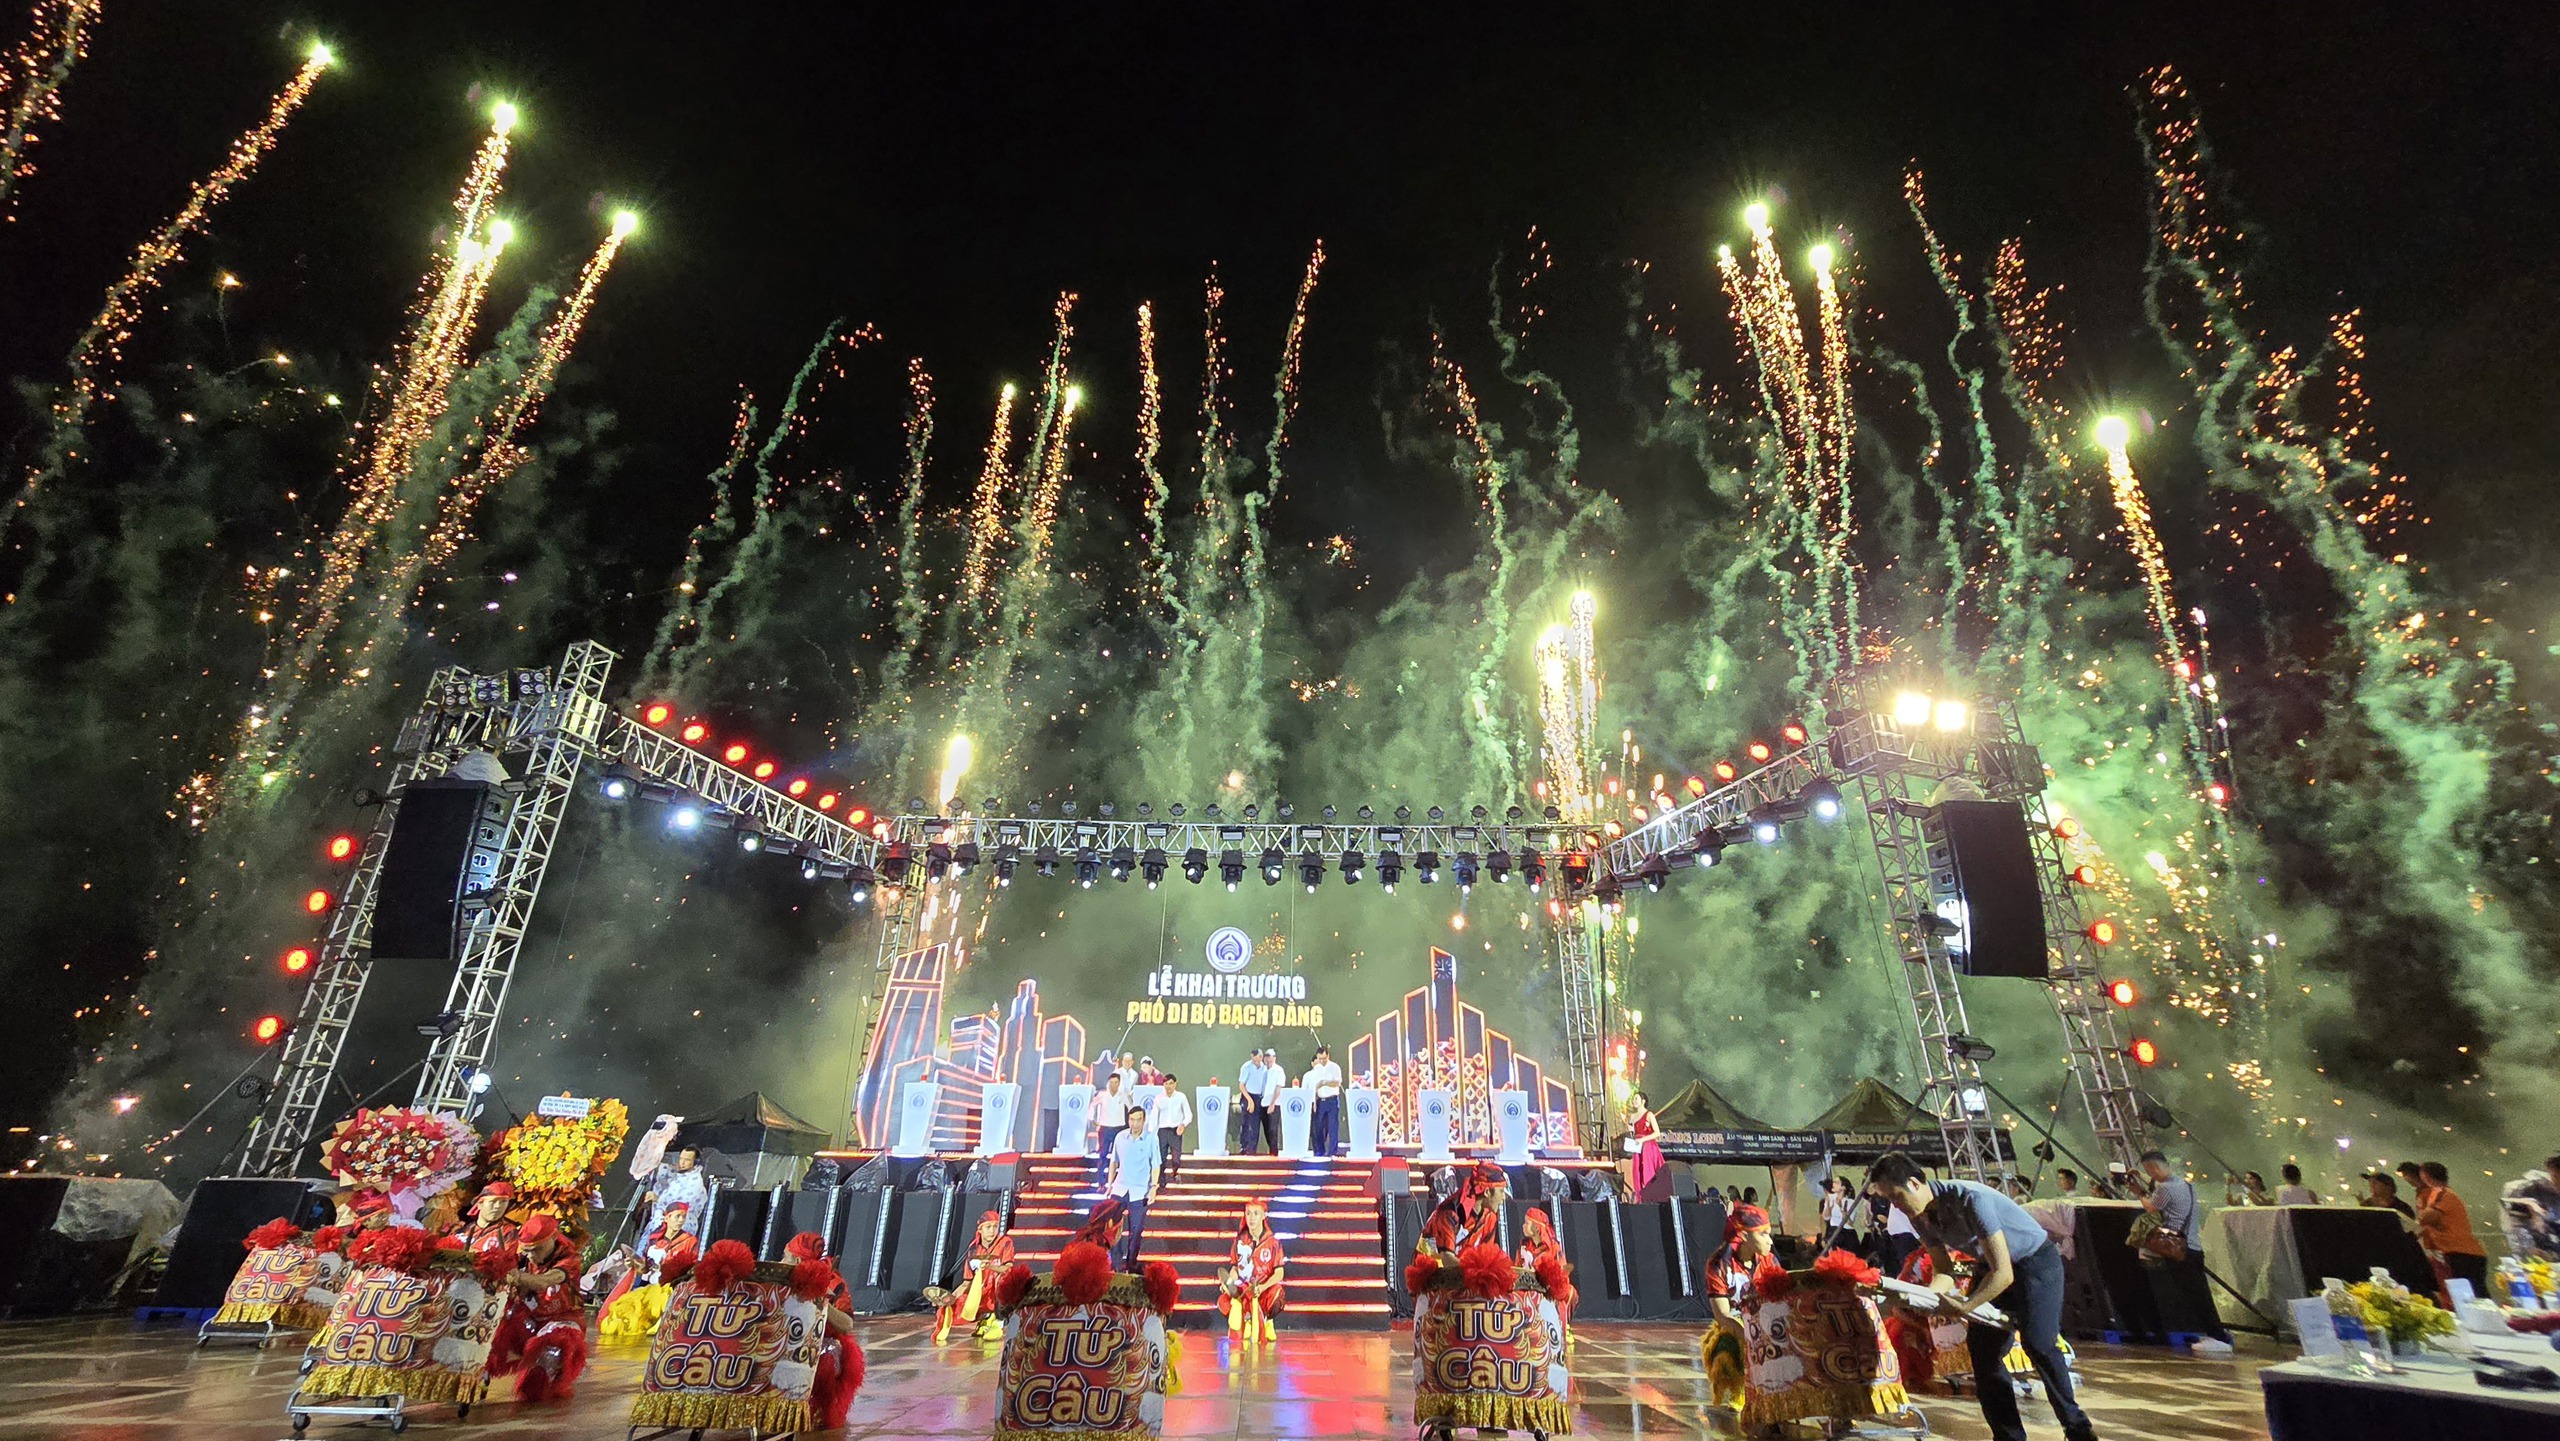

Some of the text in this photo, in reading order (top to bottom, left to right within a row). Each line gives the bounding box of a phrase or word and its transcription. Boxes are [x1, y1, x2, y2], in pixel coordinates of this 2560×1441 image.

[1148, 965, 1306, 1000] LỄ KHAI TRƯƠNG
[1127, 995, 1165, 1024] PHỐ
[1167, 1002, 1188, 1024] ĐI
[1191, 999, 1216, 1028] BỘ
[1219, 1004, 1269, 1029] BẠCH
[1693, 1132, 1724, 1145] LONG
[1833, 1131, 1875, 1145] HOÀNG
[1876, 1134, 1910, 1146] LOG
[252, 1247, 303, 1273] Tứ
[231, 1274, 295, 1301] Câu
[356, 1275, 427, 1317] Tứ
[687, 1291, 763, 1337] Tứ
[1450, 1299, 1525, 1342] Tứ
[326, 1320, 415, 1364] Câu
[1043, 1315, 1126, 1367] Tứ
[655, 1341, 754, 1390] Câu
[1437, 1344, 1533, 1394] Câu
[1016, 1371, 1123, 1426] Câu
